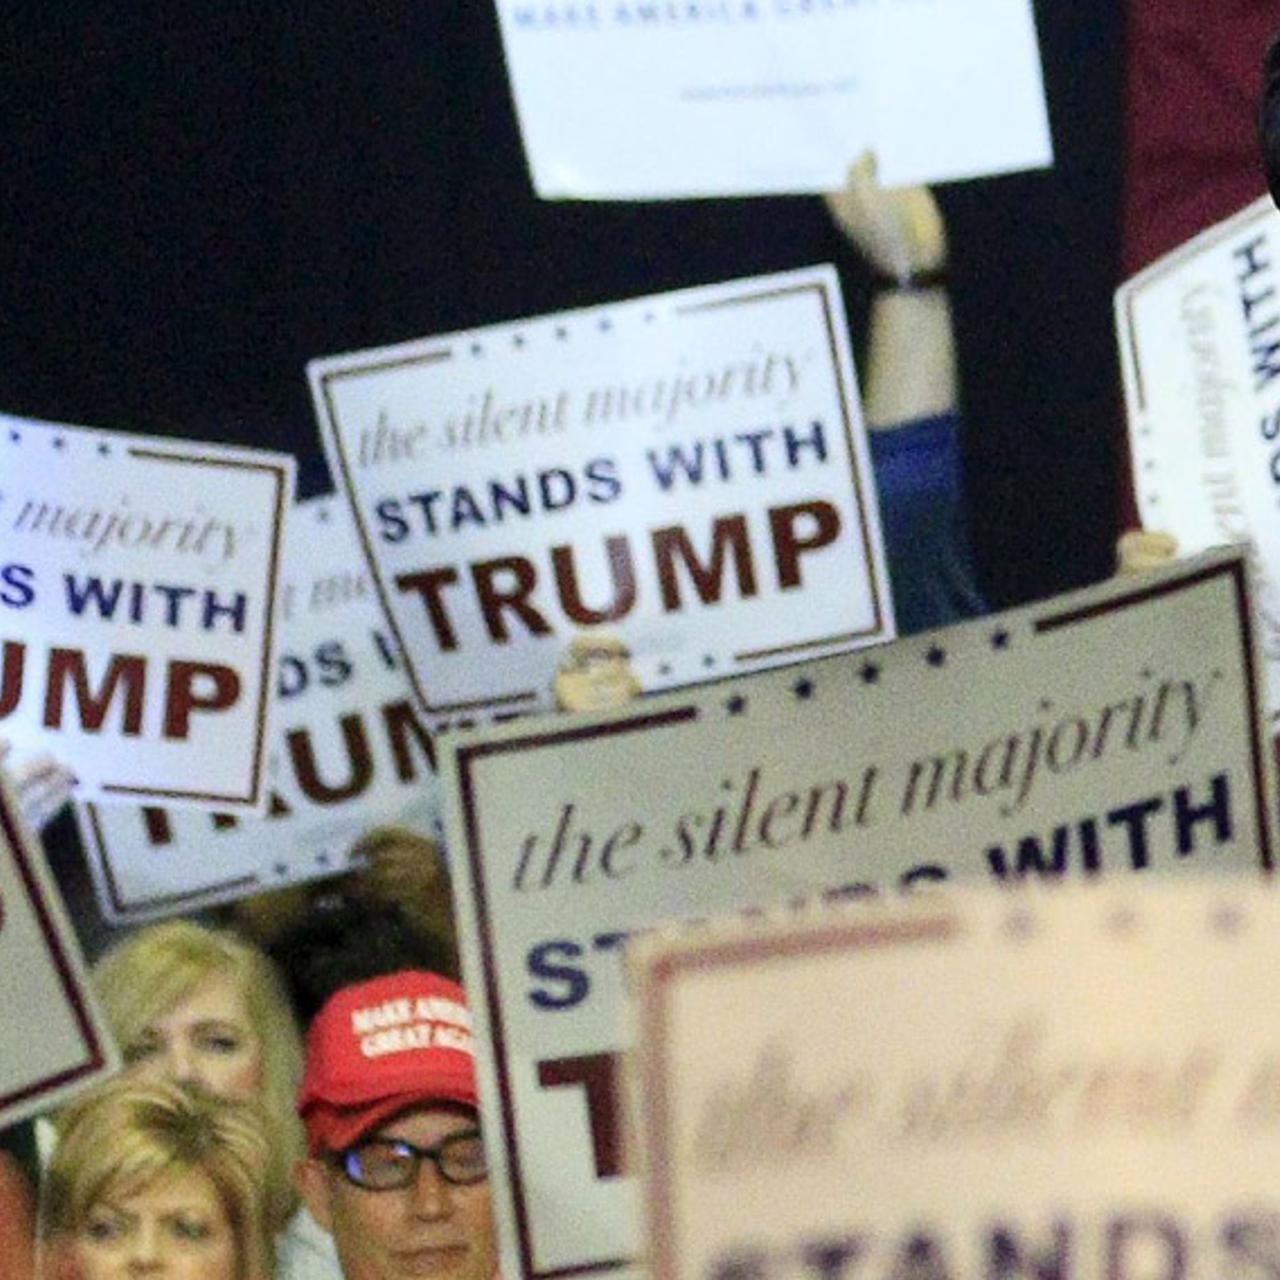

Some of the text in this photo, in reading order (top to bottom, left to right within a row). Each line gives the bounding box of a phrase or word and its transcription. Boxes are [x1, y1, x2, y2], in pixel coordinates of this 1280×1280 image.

[357, 348, 806, 466] the silent majority
[376, 419, 830, 543] STANDS WITH
[62, 572, 249, 634] WITH
[394, 499, 843, 653] TRUMP
[511, 663, 1225, 894] the silent majority
[986, 772, 1238, 888] WITH
